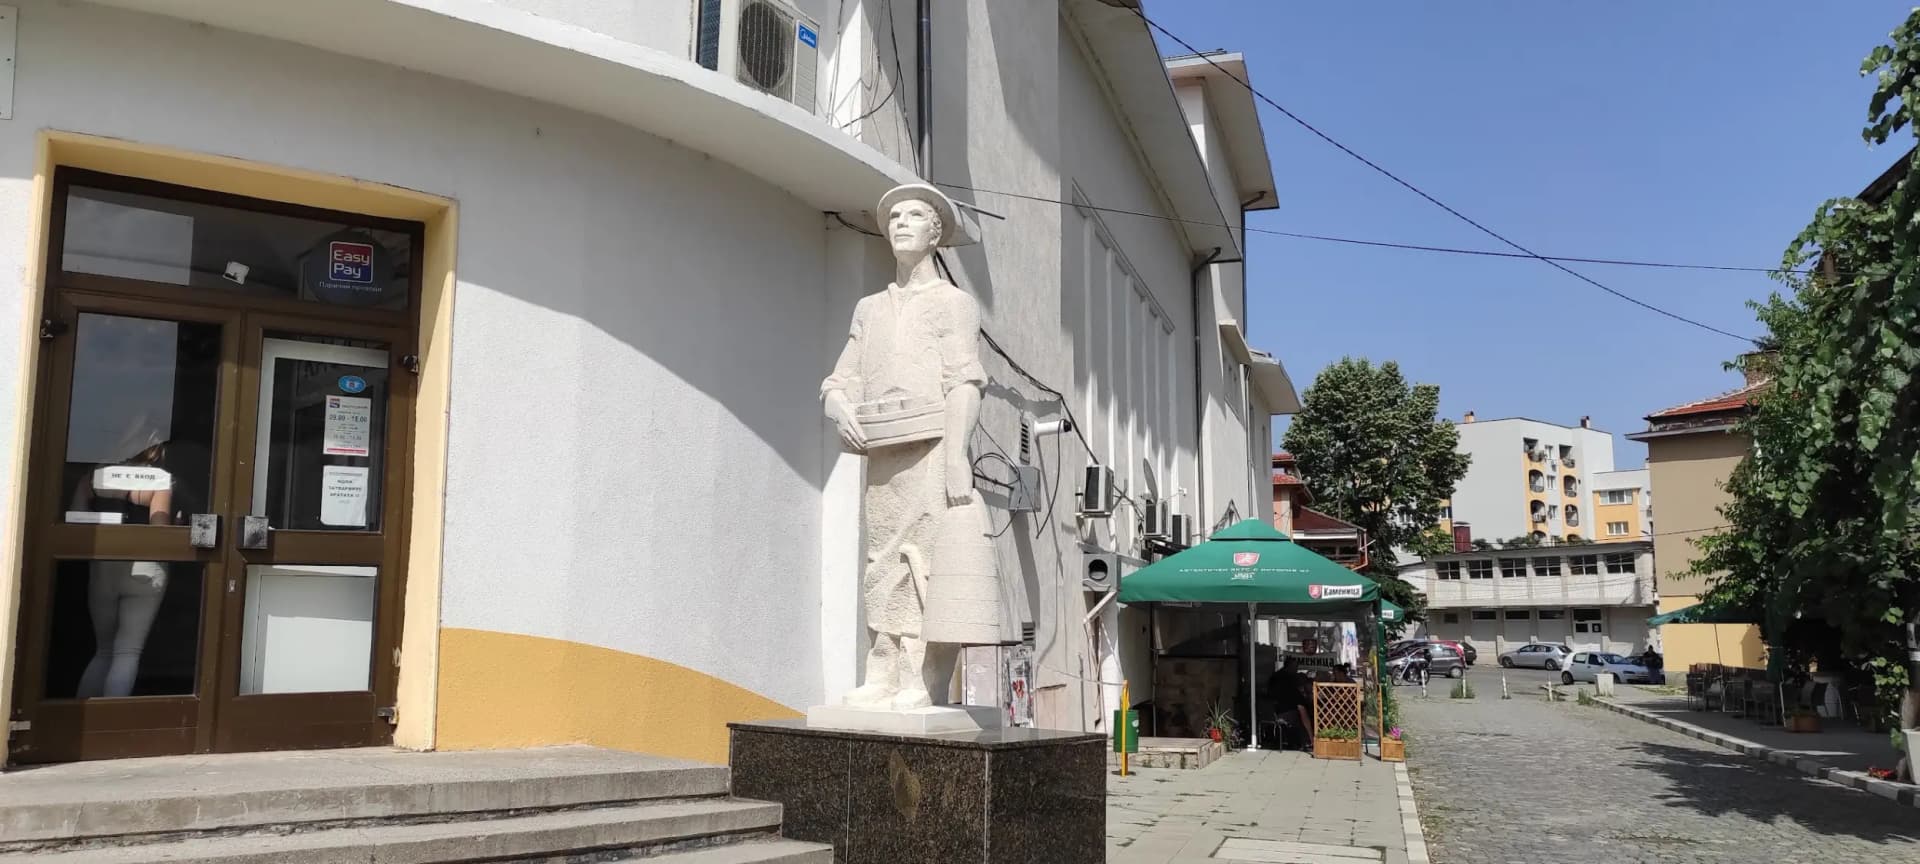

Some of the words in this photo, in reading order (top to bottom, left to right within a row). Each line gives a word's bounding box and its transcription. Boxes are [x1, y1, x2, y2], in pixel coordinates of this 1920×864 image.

[333, 249, 370, 266] Easy
[333, 262, 361, 279] Pay
[1323, 586, 1361, 597] Каменица
